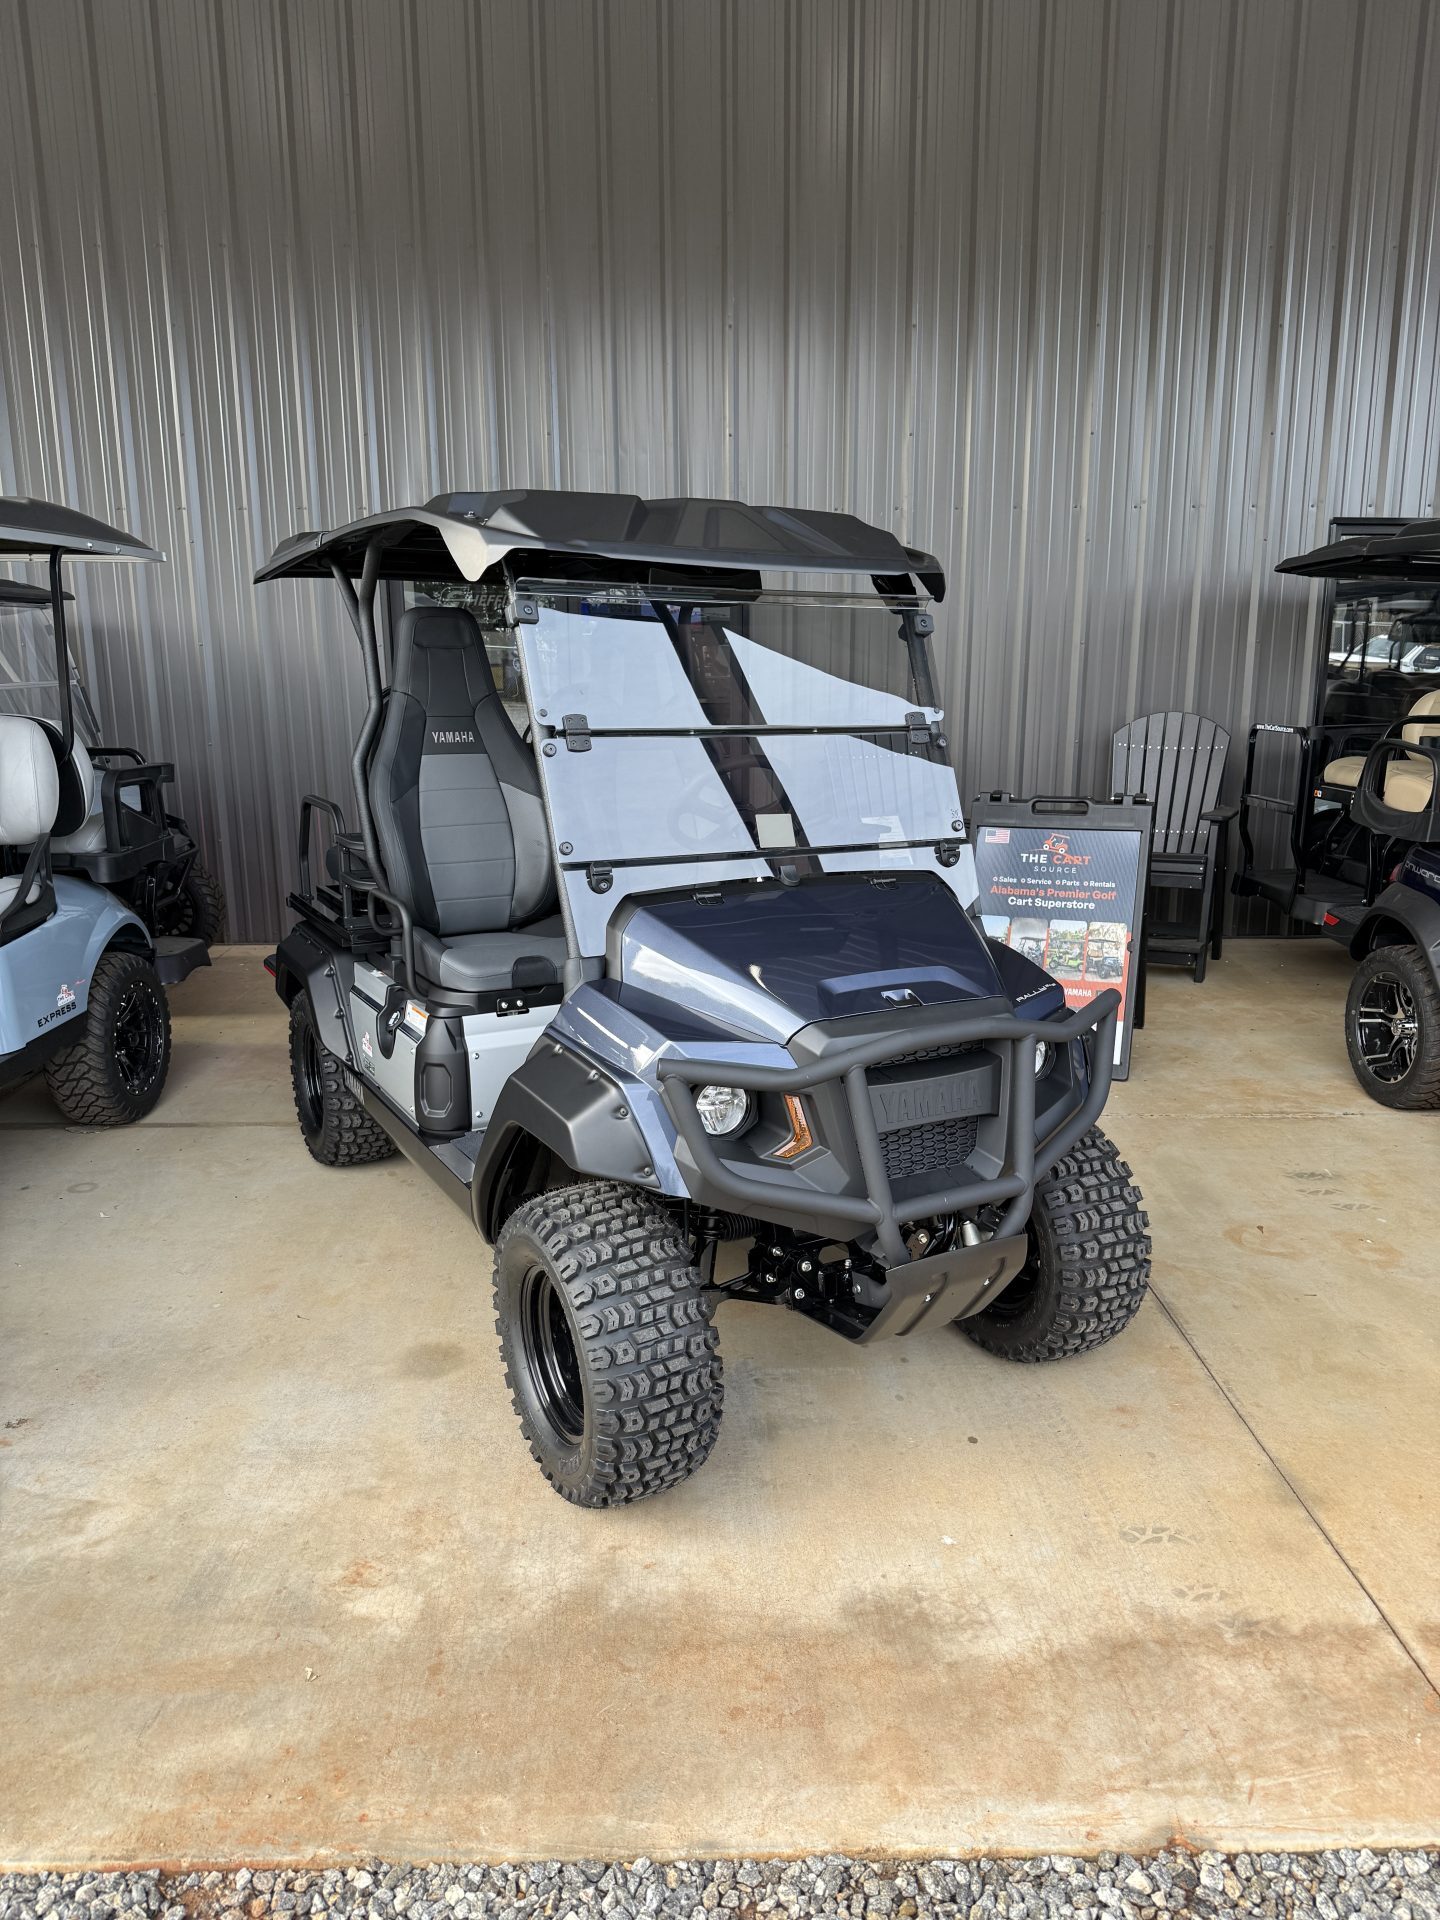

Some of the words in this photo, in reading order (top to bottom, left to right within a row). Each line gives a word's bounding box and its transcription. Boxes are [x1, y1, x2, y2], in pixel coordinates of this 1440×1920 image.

[431, 731, 475, 743] YAMAHA
[1020, 853, 1047, 863] THE
[1052, 854, 1091, 865] CART
[1033, 865, 1077, 873] SOURCE
[1026, 877, 1052, 885] Service
[1061, 879, 1080, 887] Parts
[990, 885, 1045, 897] Alabama's
[1047, 888, 1090, 899] Premier
[1092, 890, 1117, 900] Golf
[1007, 896, 1033, 906] Cart
[1034, 898, 1096, 909] Superstore
[1064, 988, 1092, 997] YAMAHA
[37, 1001, 77, 1027] EXPRESS
[879, 1079, 984, 1124] YAMAHA
